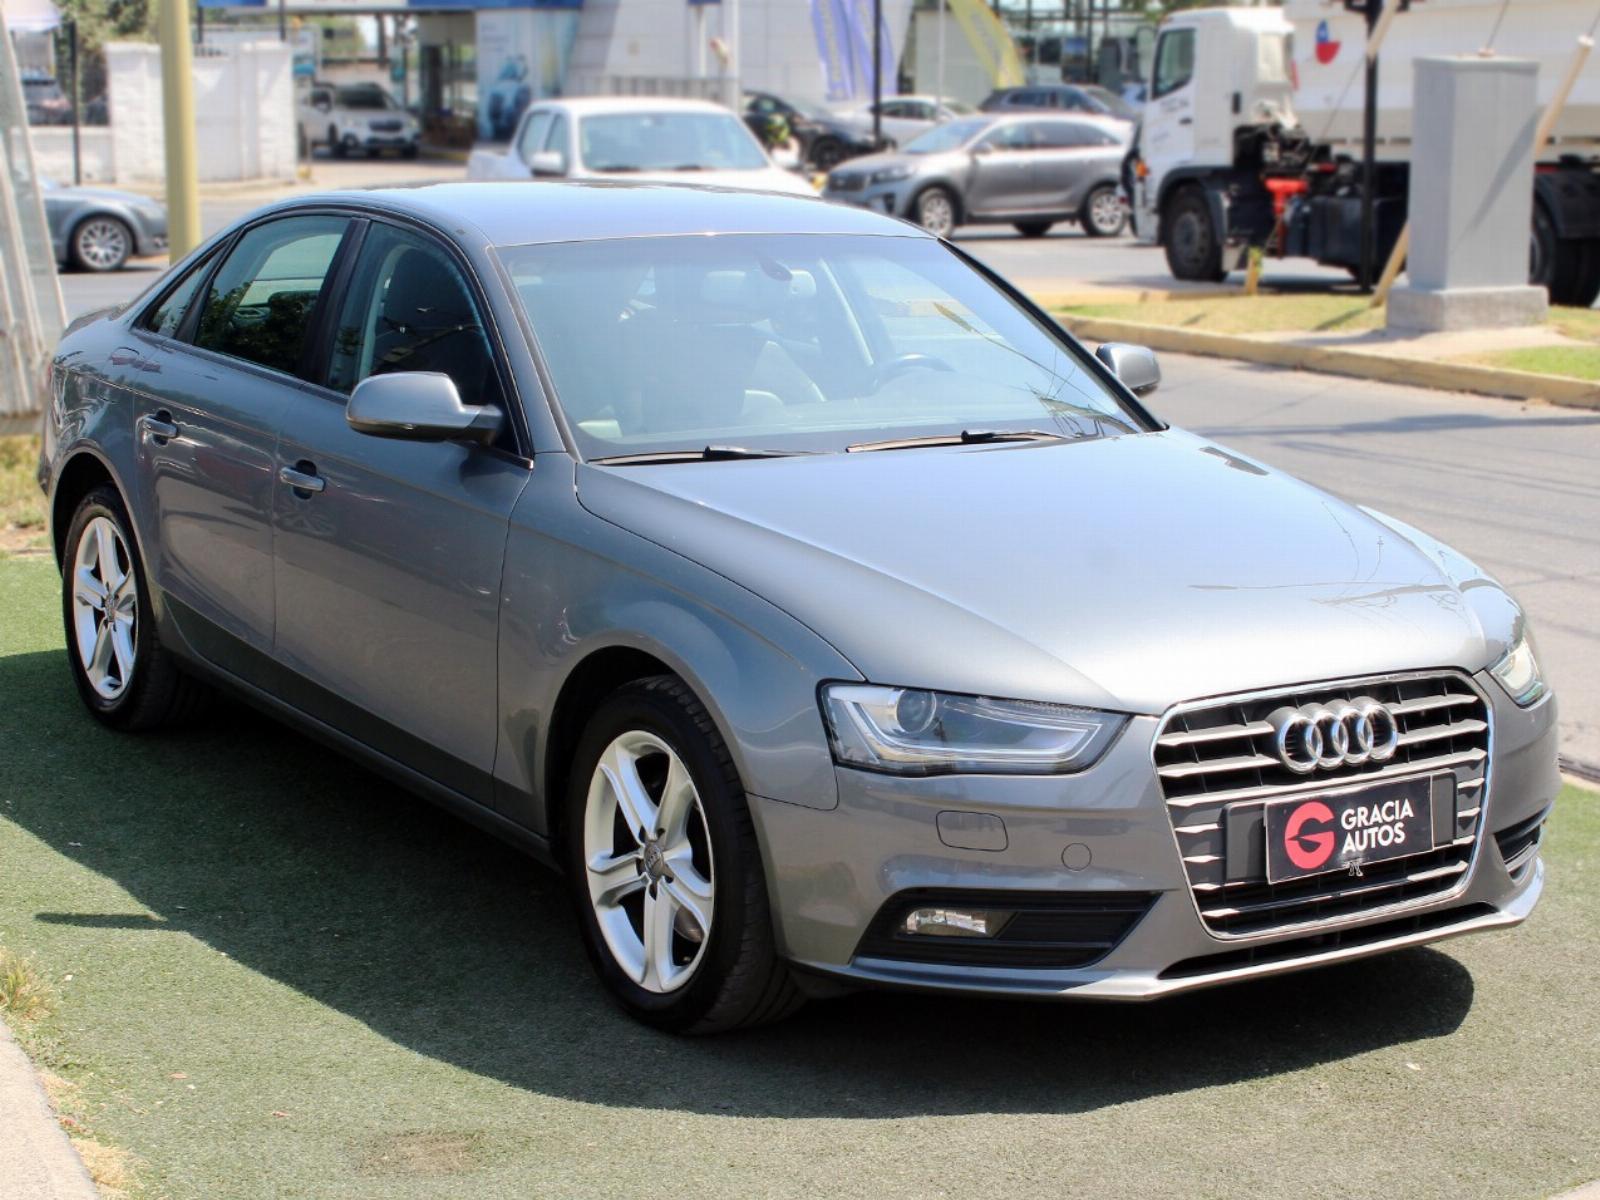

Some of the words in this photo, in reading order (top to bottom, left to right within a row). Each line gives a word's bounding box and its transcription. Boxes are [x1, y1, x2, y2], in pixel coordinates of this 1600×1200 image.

[1341, 798, 1414, 830] GRACIA
[1284, 801, 1336, 870] G
[1342, 822, 1406, 854] AUTOS
